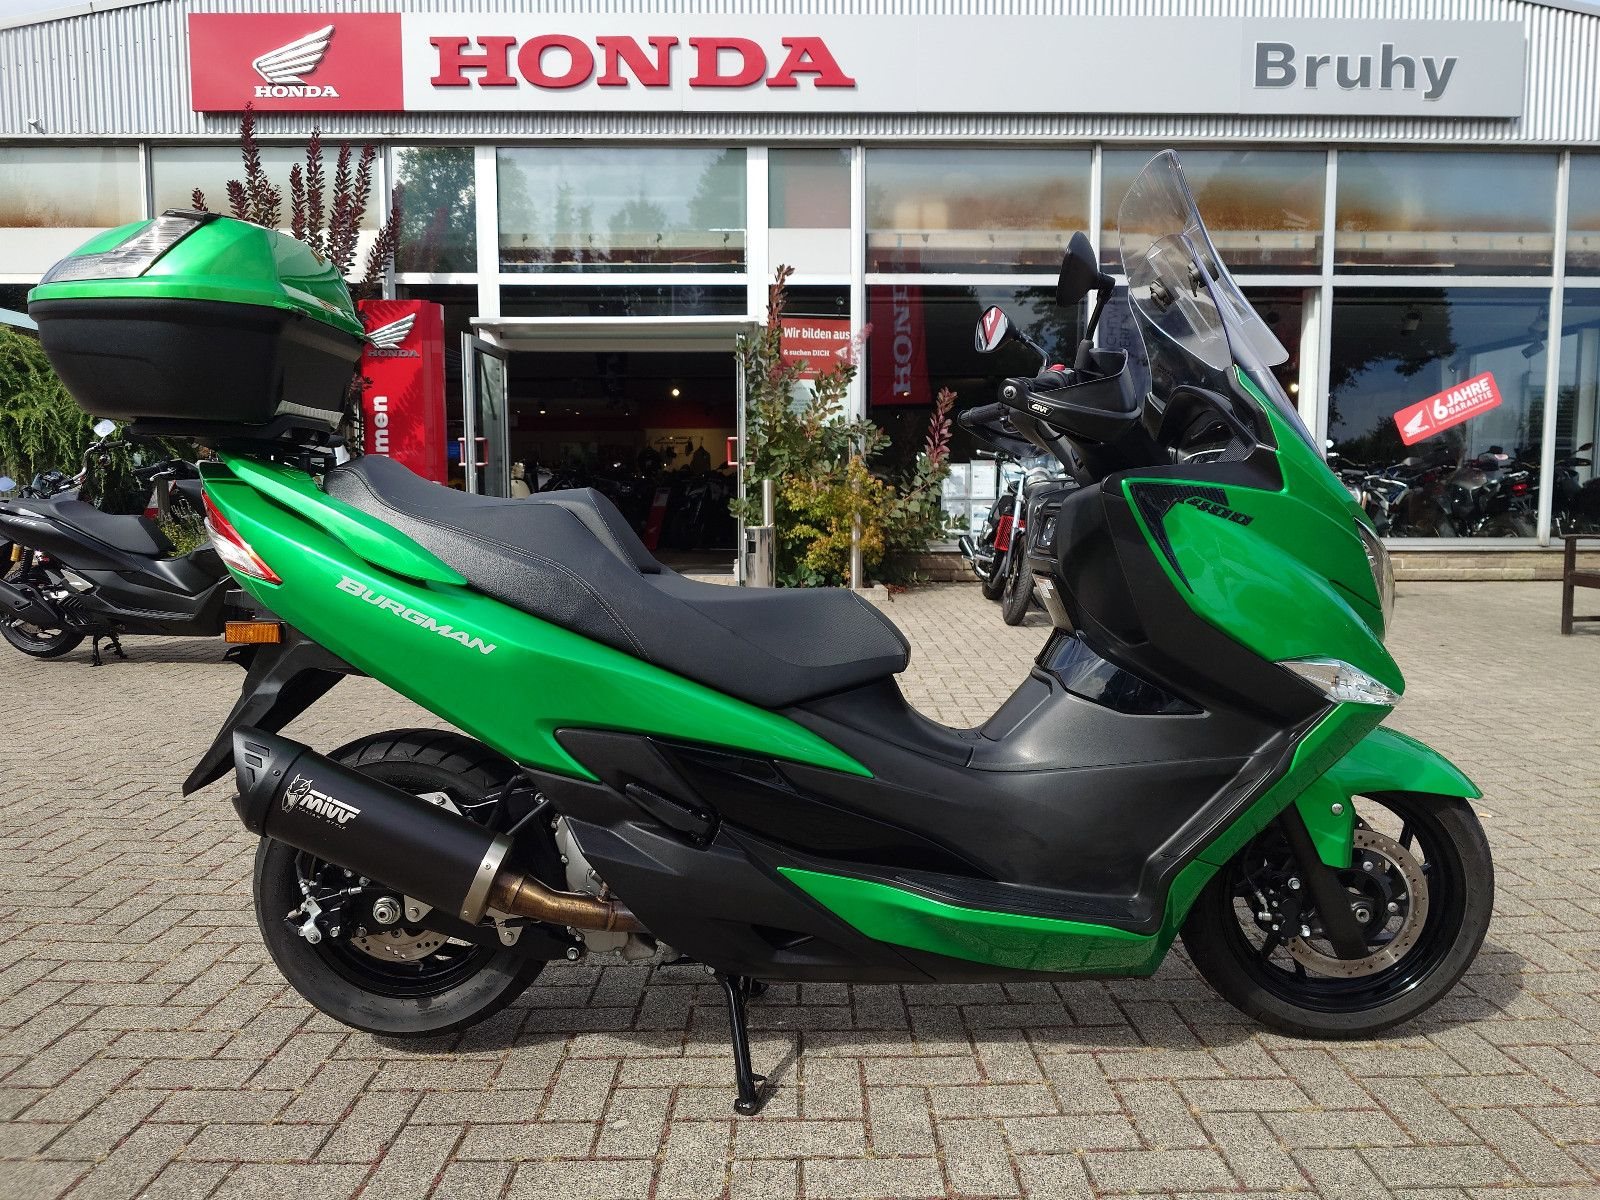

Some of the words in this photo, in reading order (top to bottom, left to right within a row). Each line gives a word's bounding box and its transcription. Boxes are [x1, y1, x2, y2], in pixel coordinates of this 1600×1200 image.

[429, 34, 857, 88] HONDA
[1253, 41, 1459, 101] Bruhy
[254, 85, 340, 98] HONDA
[783, 327, 801, 338] Wir
[802, 328, 832, 339] bilden
[833, 330, 851, 340] aus
[367, 350, 420, 358] HONDA
[812, 349, 830, 357] DICH
[1433, 398, 1448, 420] 6
[1446, 377, 1491, 407] JAHRE
[1448, 390, 1494, 415] GARANTIE
[373, 396, 389, 457] men
[335, 574, 498, 655] BURGMAN
